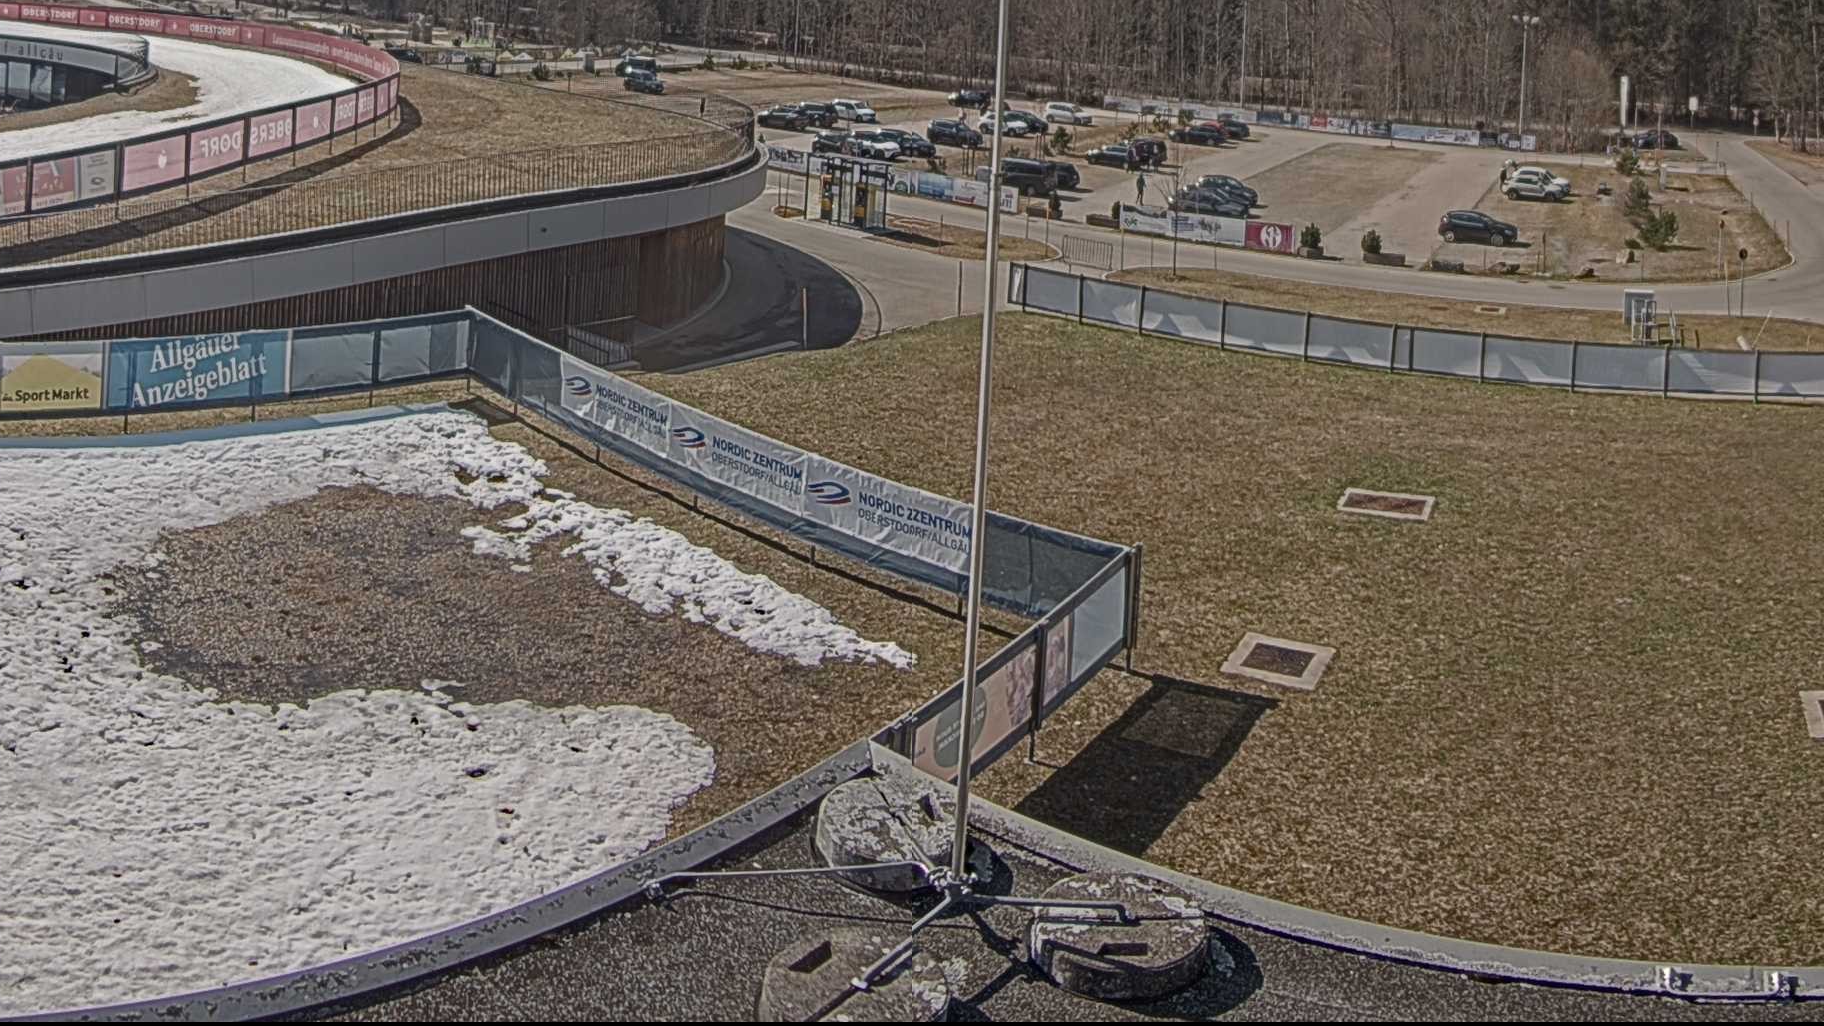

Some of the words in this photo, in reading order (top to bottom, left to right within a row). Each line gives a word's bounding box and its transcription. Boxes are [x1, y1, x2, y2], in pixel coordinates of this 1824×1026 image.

[150, 333, 241, 373] Allgäuer
[131, 352, 268, 409] Anzeigeblatt
[596, 384, 626, 407] NORDIC
[712, 436, 752, 461] NORDIC
[752, 452, 803, 479] ZENTRUM
[858, 491, 905, 517] NORDIC
